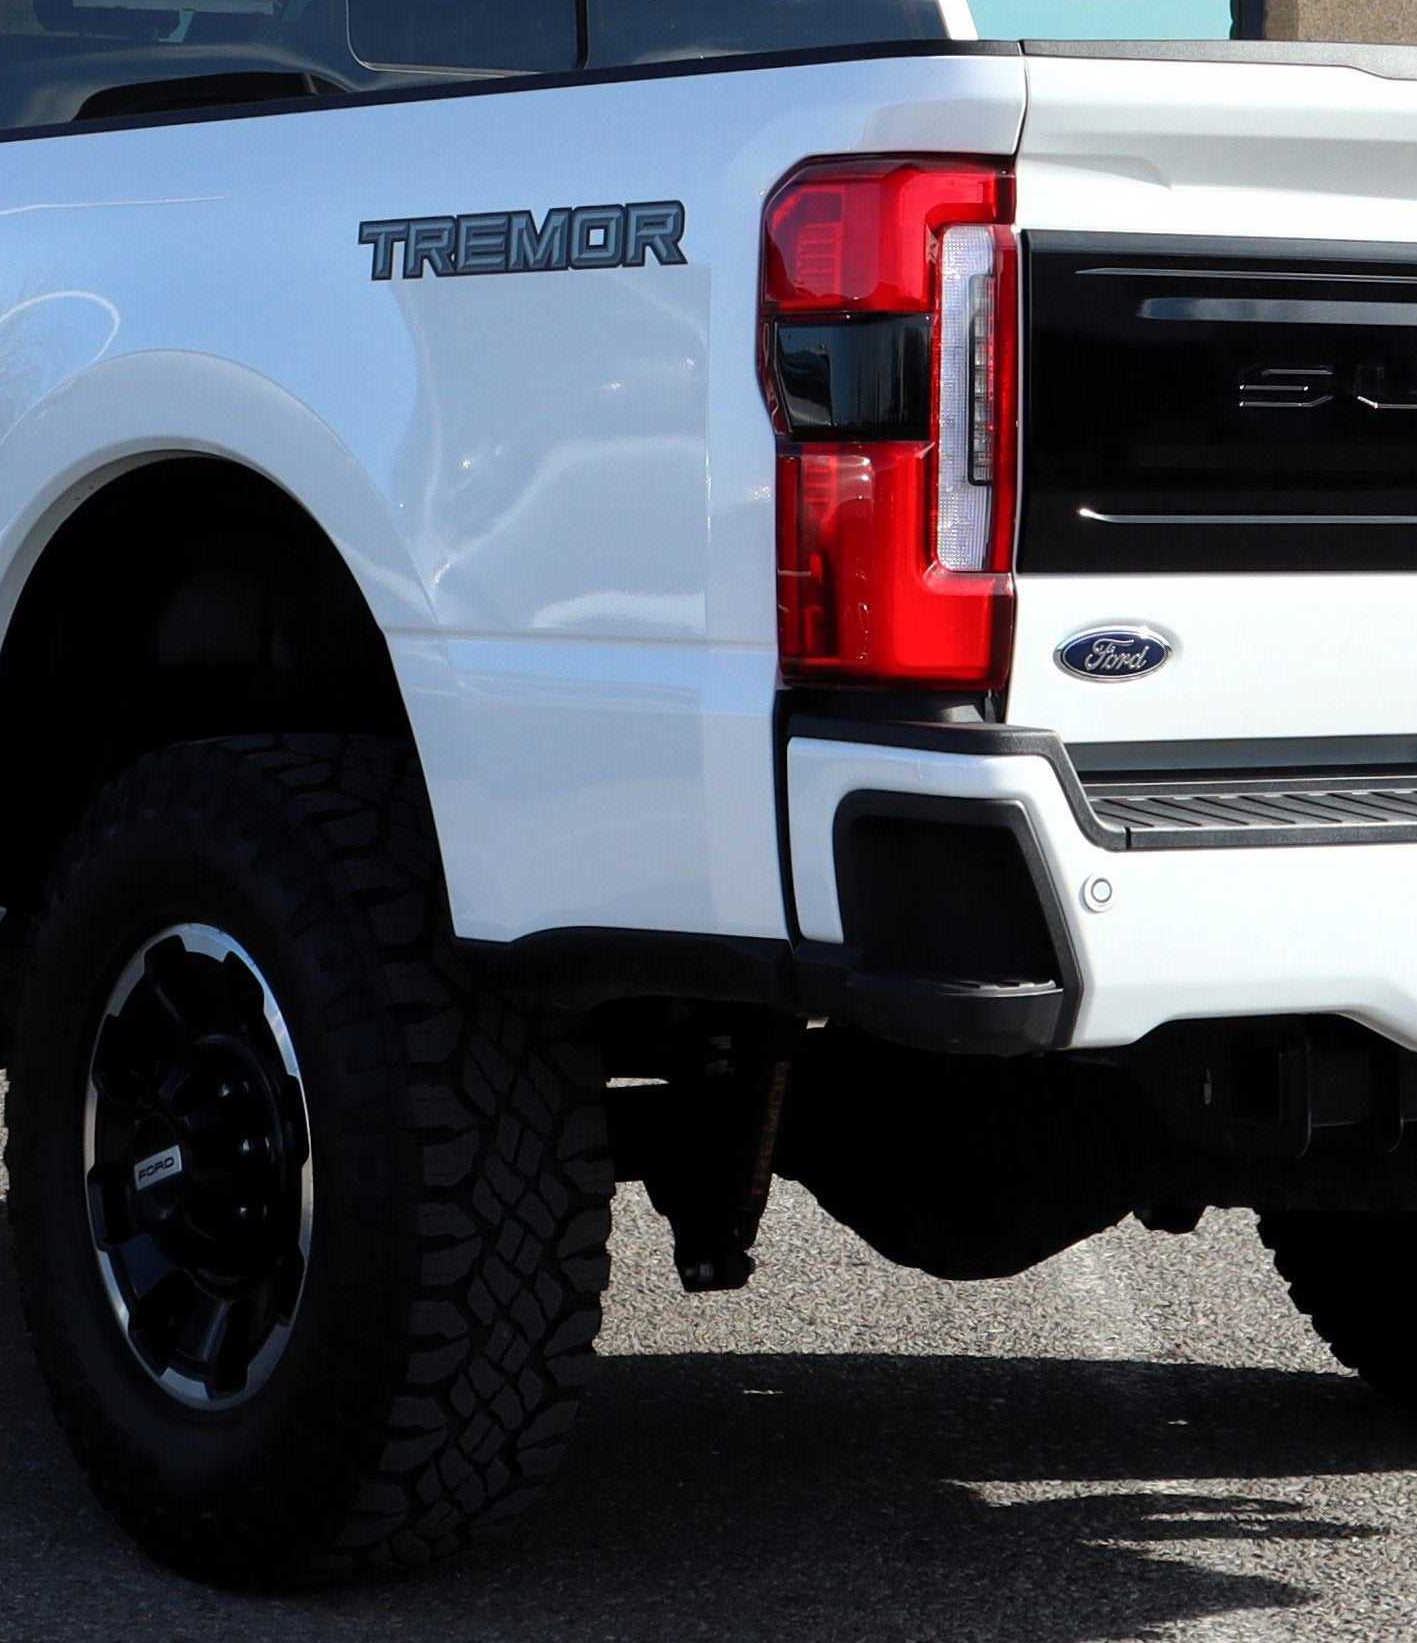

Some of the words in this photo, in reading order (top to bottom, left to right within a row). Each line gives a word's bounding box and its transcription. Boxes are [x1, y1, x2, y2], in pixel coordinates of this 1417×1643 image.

[358, 200, 688, 281] TREMOR
[1084, 638, 1151, 671] Ford
[138, 1156, 175, 1181] FORD
